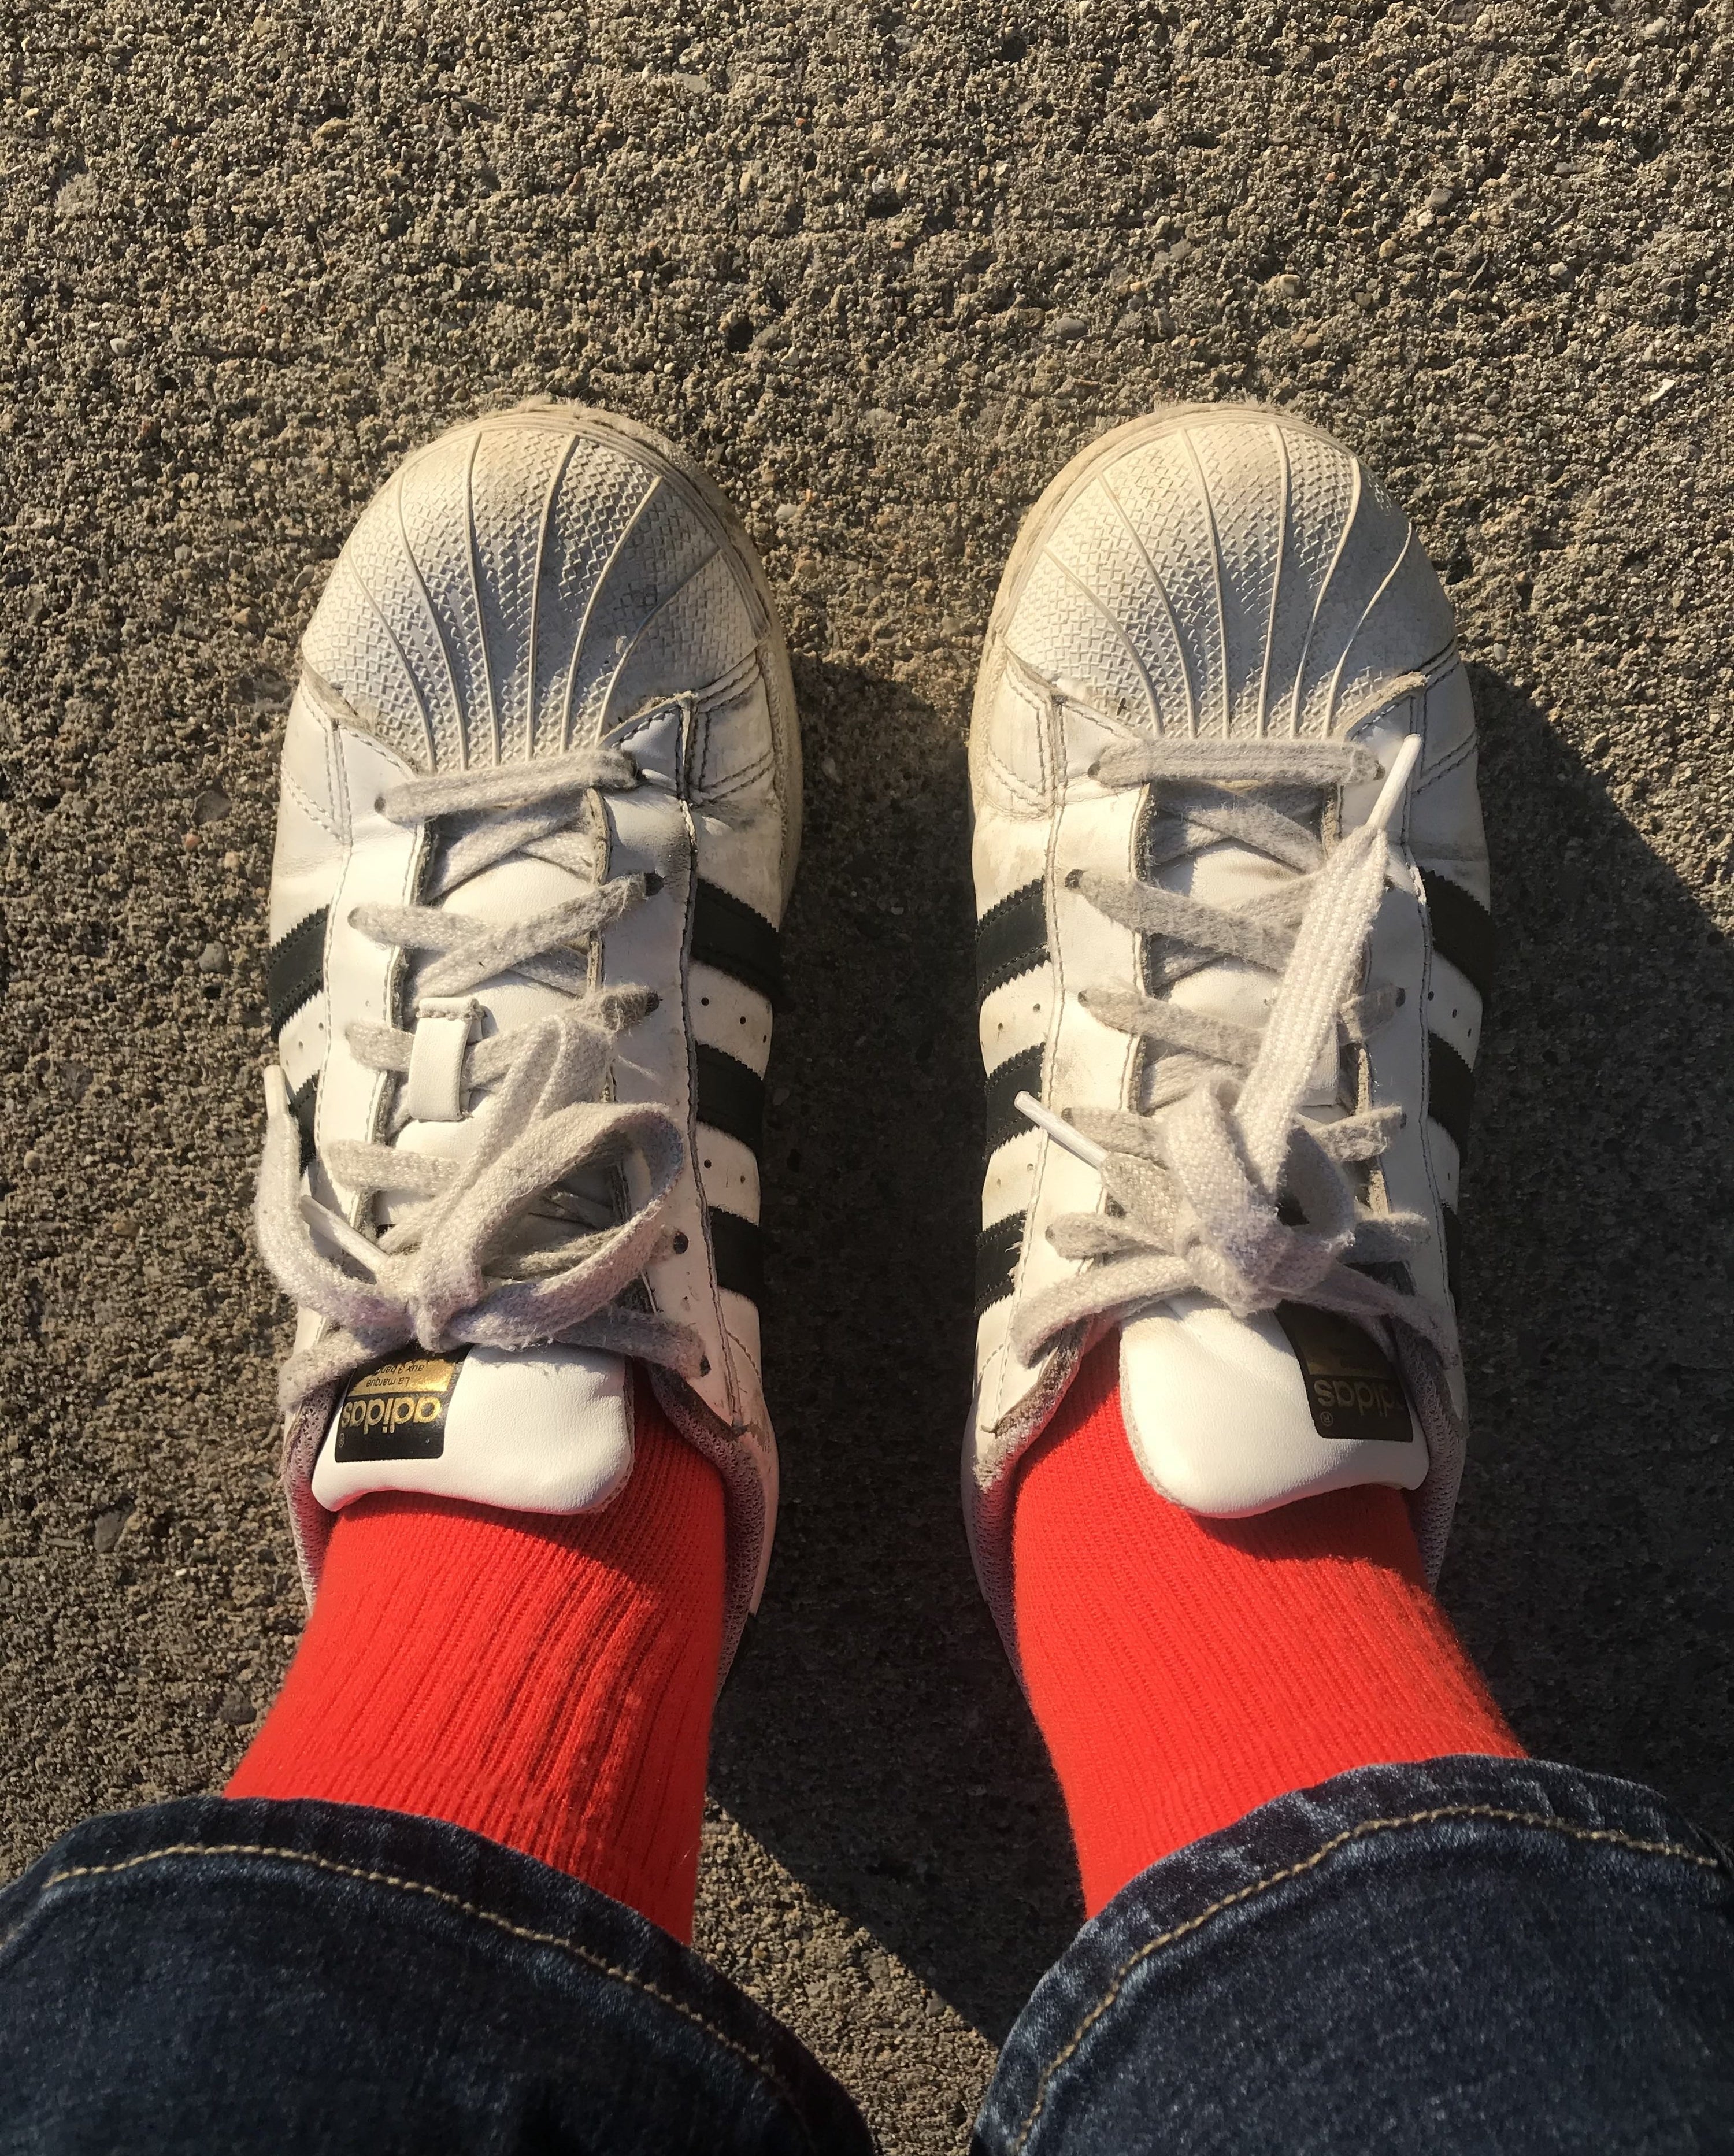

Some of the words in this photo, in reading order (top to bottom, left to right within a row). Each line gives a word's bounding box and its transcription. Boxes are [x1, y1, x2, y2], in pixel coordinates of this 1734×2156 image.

[397, 1365, 405, 1375] 3
[406, 1365, 425, 1373] aux
[366, 1377, 397, 1388] marque
[398, 1377, 410, 1386] La
[341, 1396, 442, 1435] adidas
